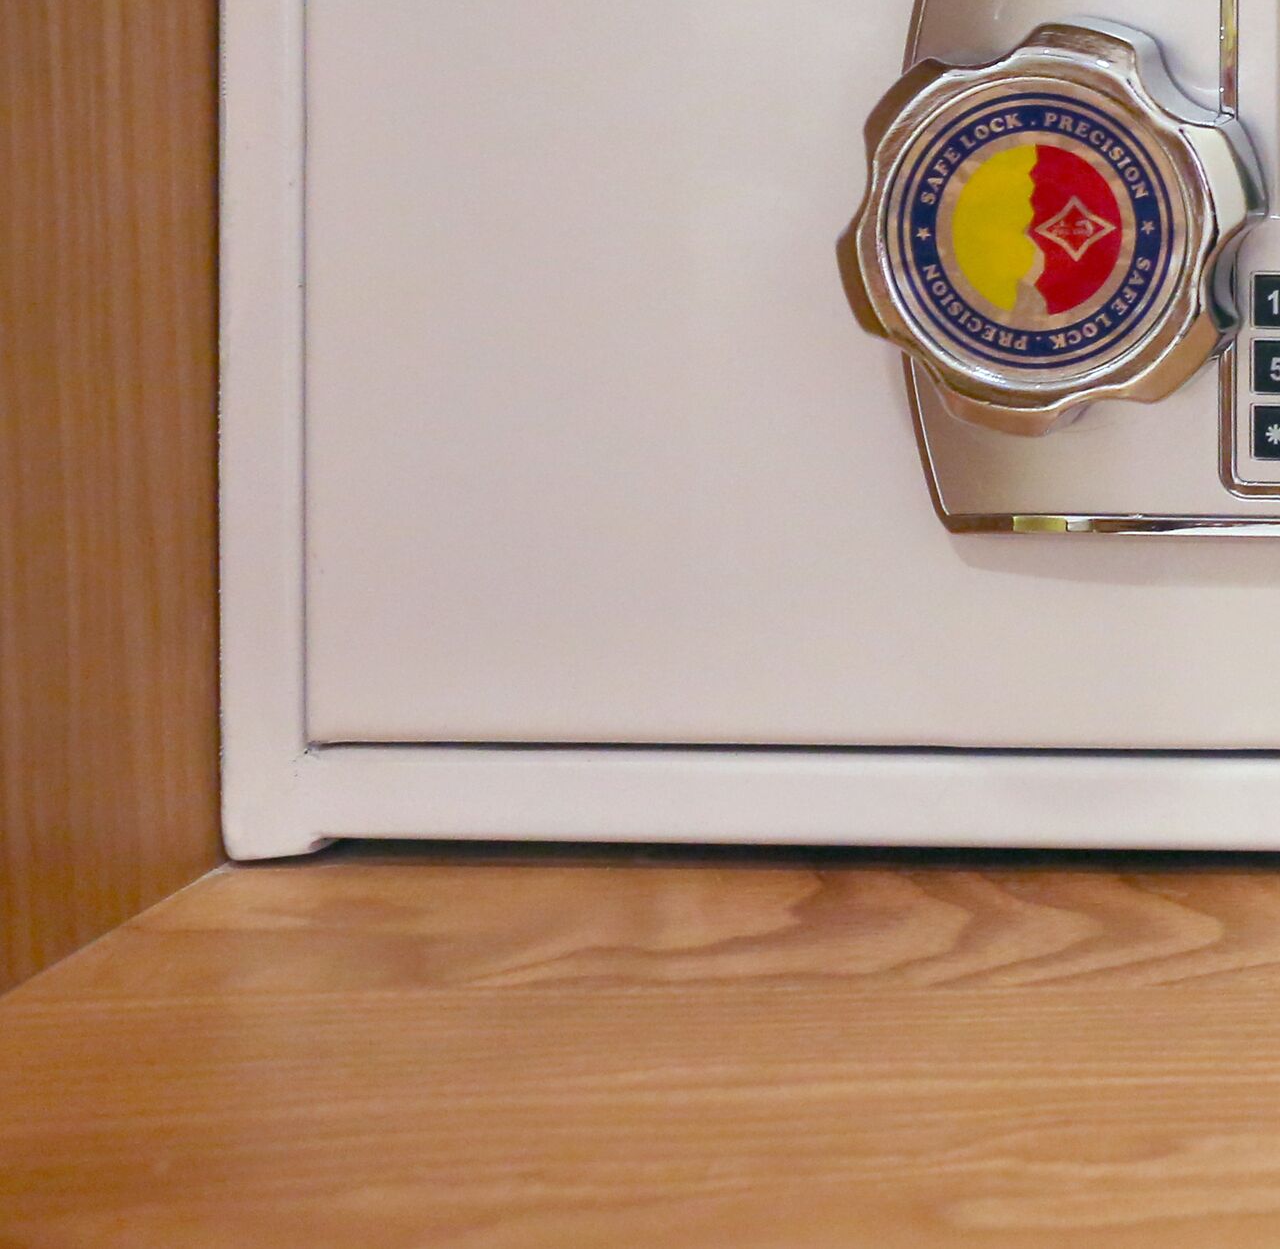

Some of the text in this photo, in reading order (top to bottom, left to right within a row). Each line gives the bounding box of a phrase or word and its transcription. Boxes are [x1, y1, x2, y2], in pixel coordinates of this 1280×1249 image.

[919, 112, 1149, 206] SAFE LOCK PRECISION
[923, 256, 1151, 351] SAFE LOCK PRECISION
